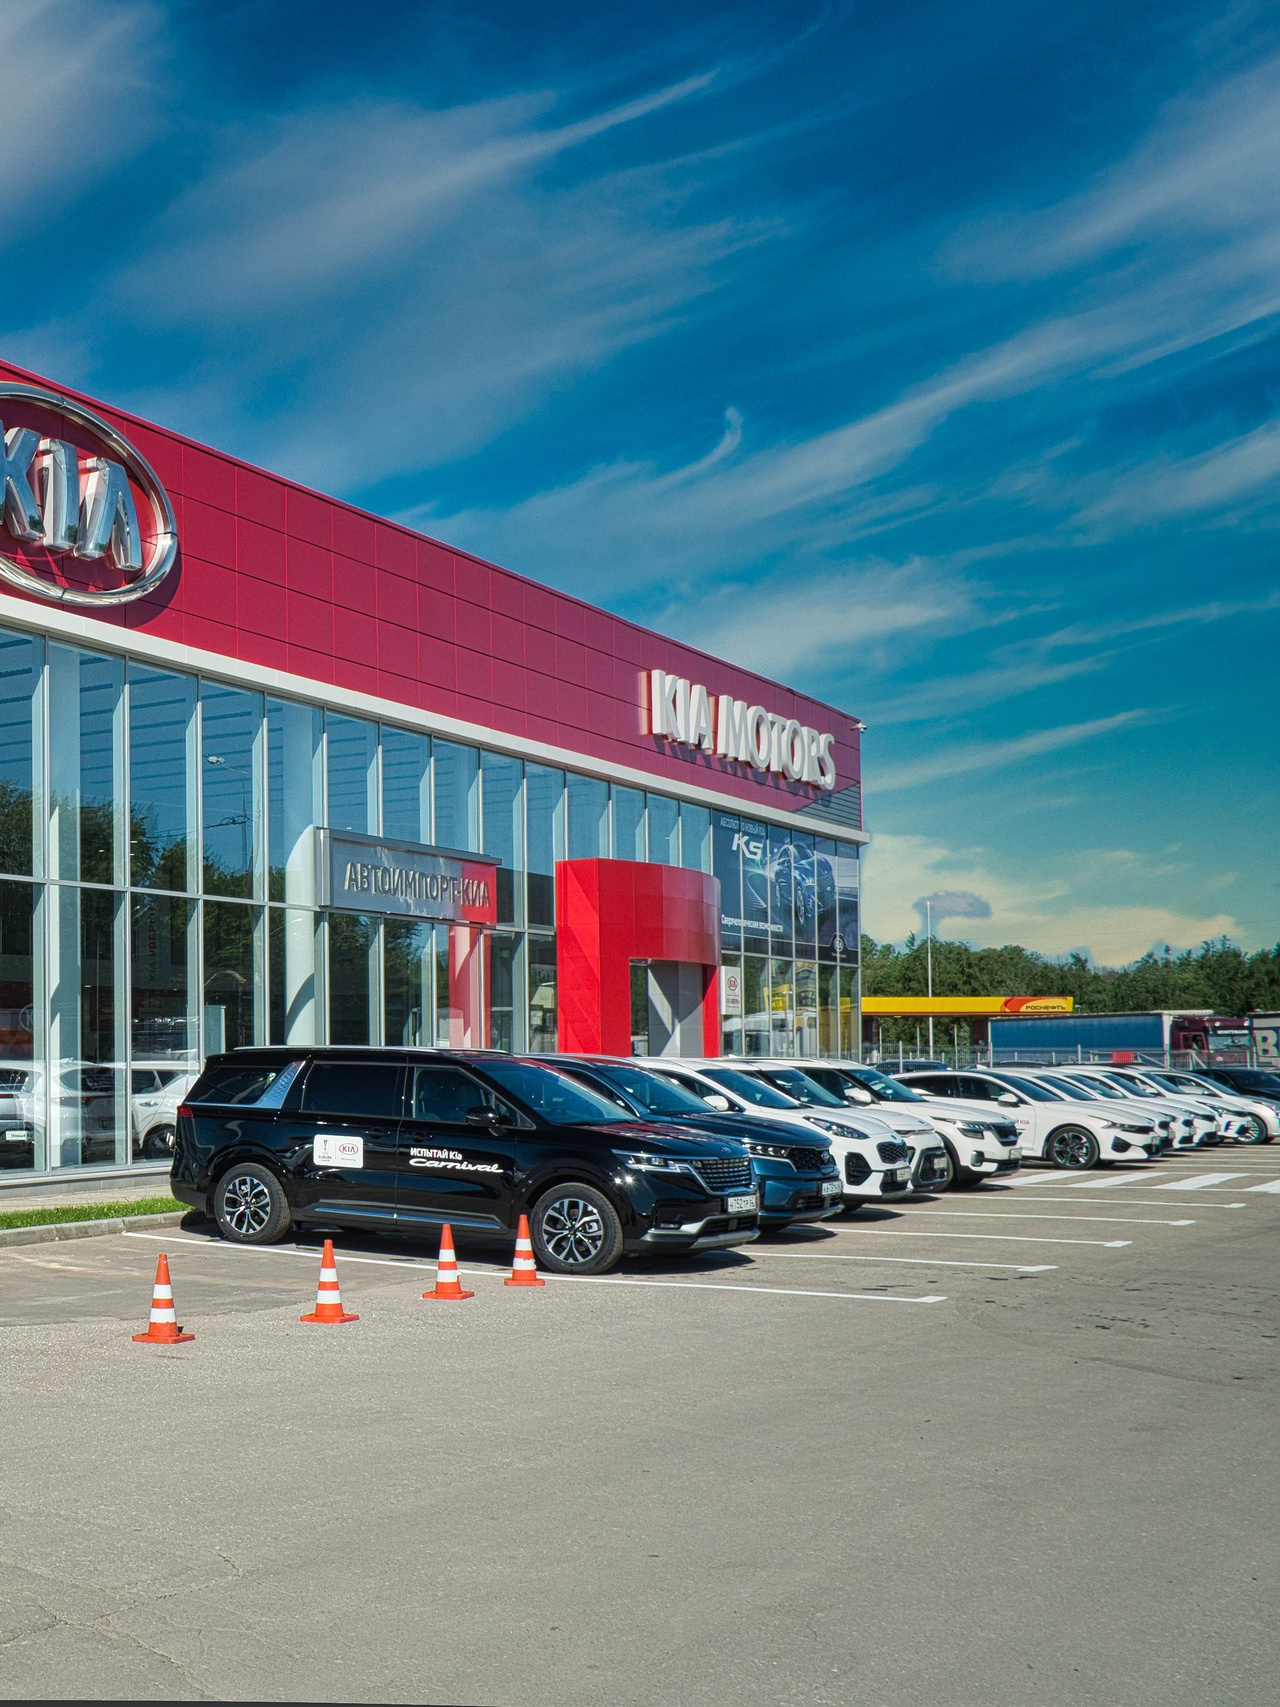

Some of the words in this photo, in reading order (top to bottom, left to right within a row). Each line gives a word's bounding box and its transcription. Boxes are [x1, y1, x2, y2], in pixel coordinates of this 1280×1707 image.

[651, 669, 715, 750] KIA
[717, 695, 837, 791] MOTORS
[731, 833, 763, 860] K5
[343, 861, 491, 908] АВТОИМПОРТ-КИА
[341, 1145, 356, 1153] KIA
[410, 1147, 448, 1159] ИСПЫТАЙ
[409, 1158, 504, 1173] Carnival
